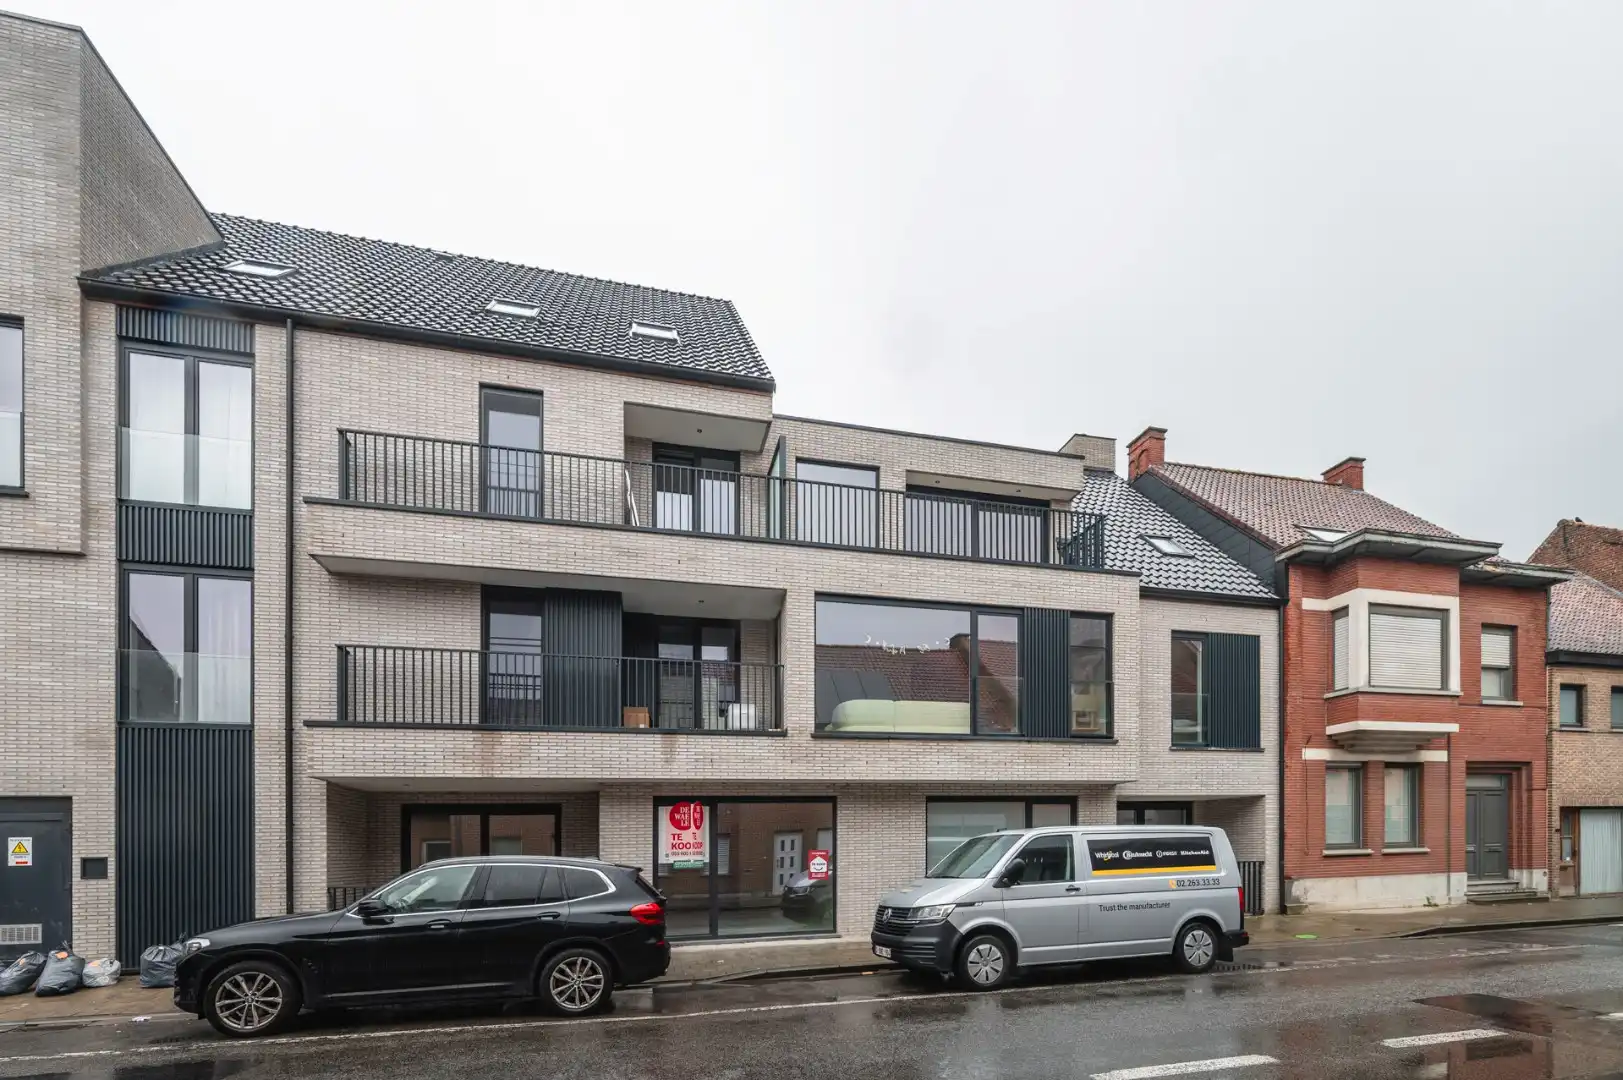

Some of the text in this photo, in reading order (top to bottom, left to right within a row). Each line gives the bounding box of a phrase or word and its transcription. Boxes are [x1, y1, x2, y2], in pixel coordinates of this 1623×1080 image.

[671, 833, 682, 841] TE
[671, 842, 691, 850] KOO
[1095, 851, 1119, 861] Whirlpool
[1098, 901, 1171, 912] Trust the manufacturer
